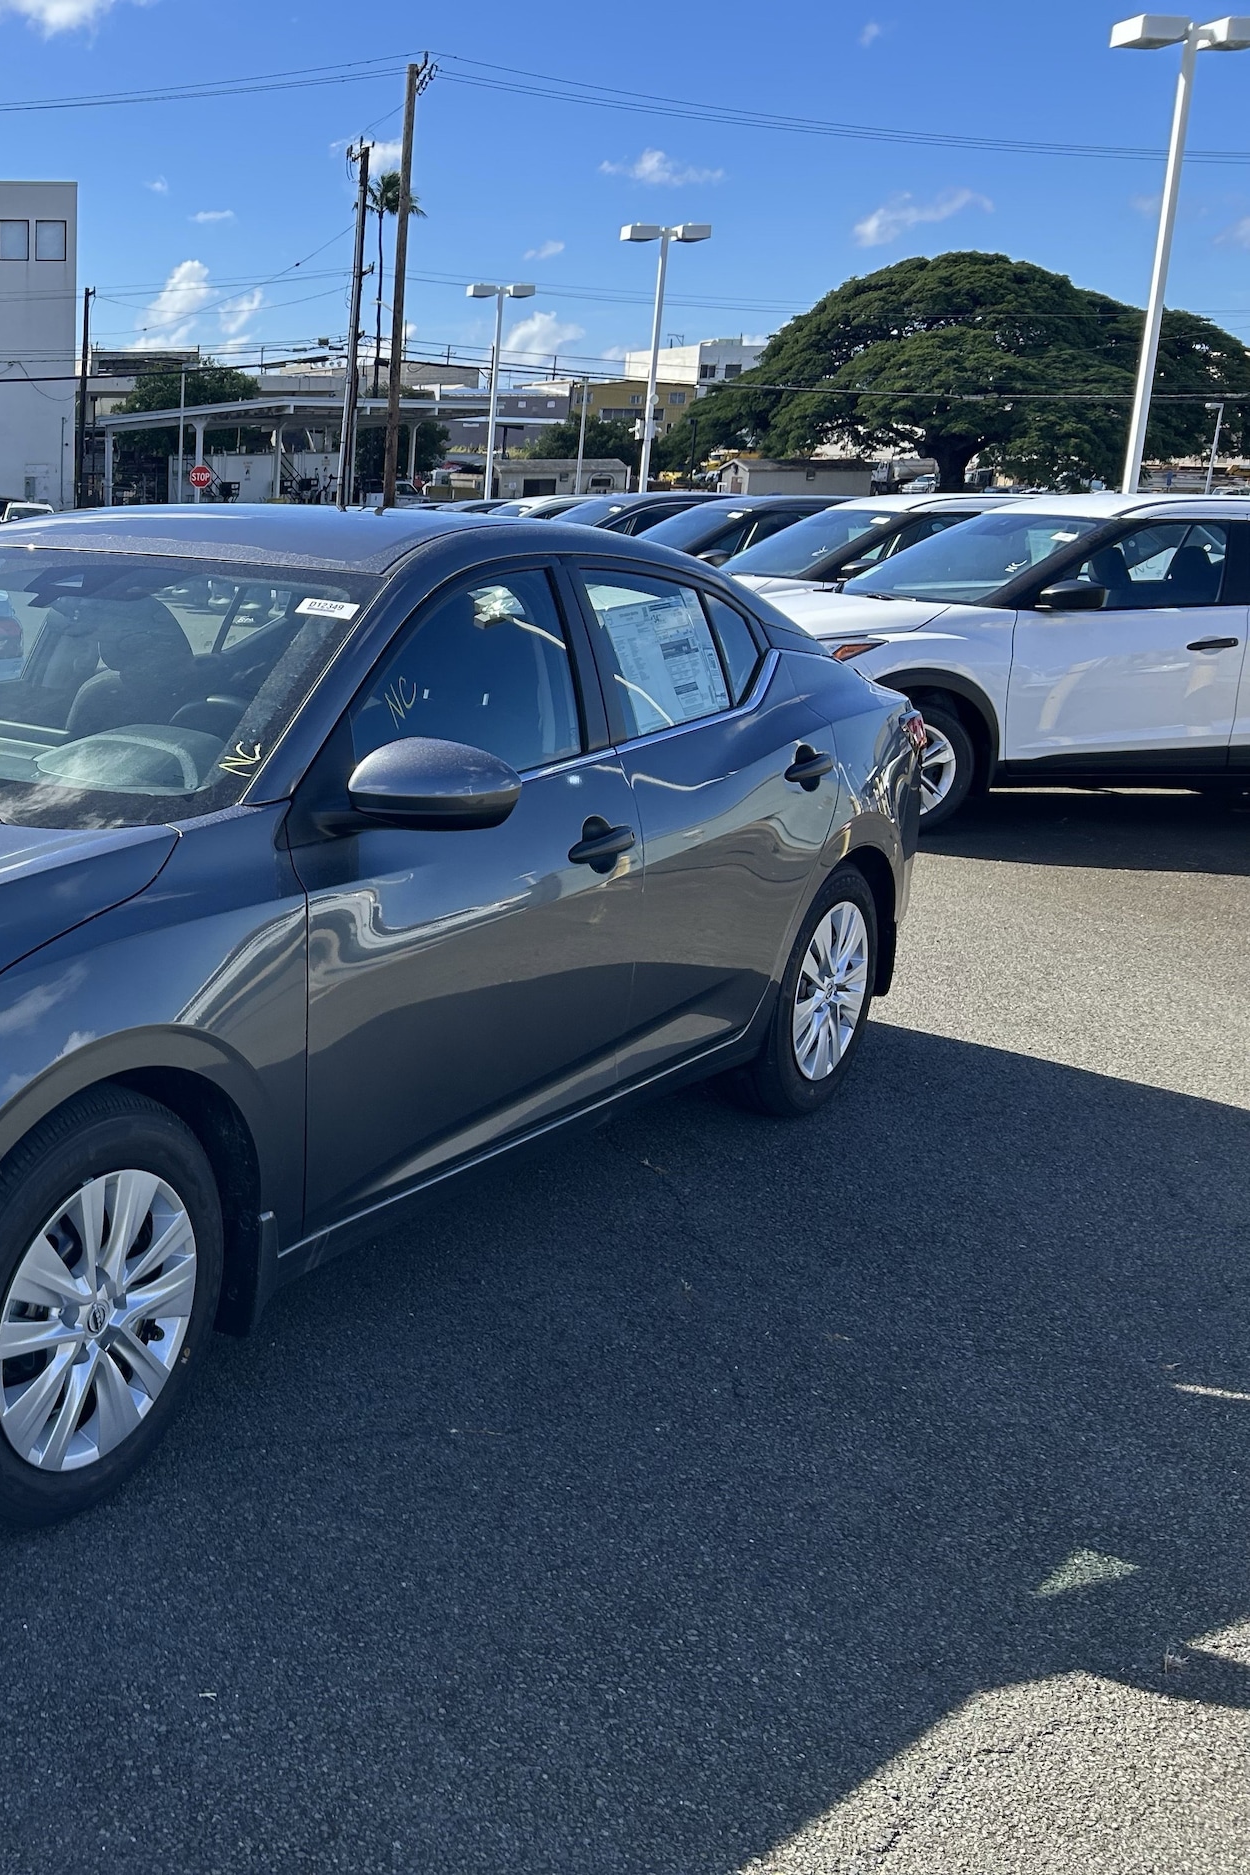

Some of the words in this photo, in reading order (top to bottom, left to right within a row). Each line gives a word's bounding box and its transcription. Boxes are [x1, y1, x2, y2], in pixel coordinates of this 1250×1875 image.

[191, 472, 210, 482] STOP
[309, 601, 345, 611] D12349
[384, 675, 417, 730] NC
[218, 740, 261, 778] NC
